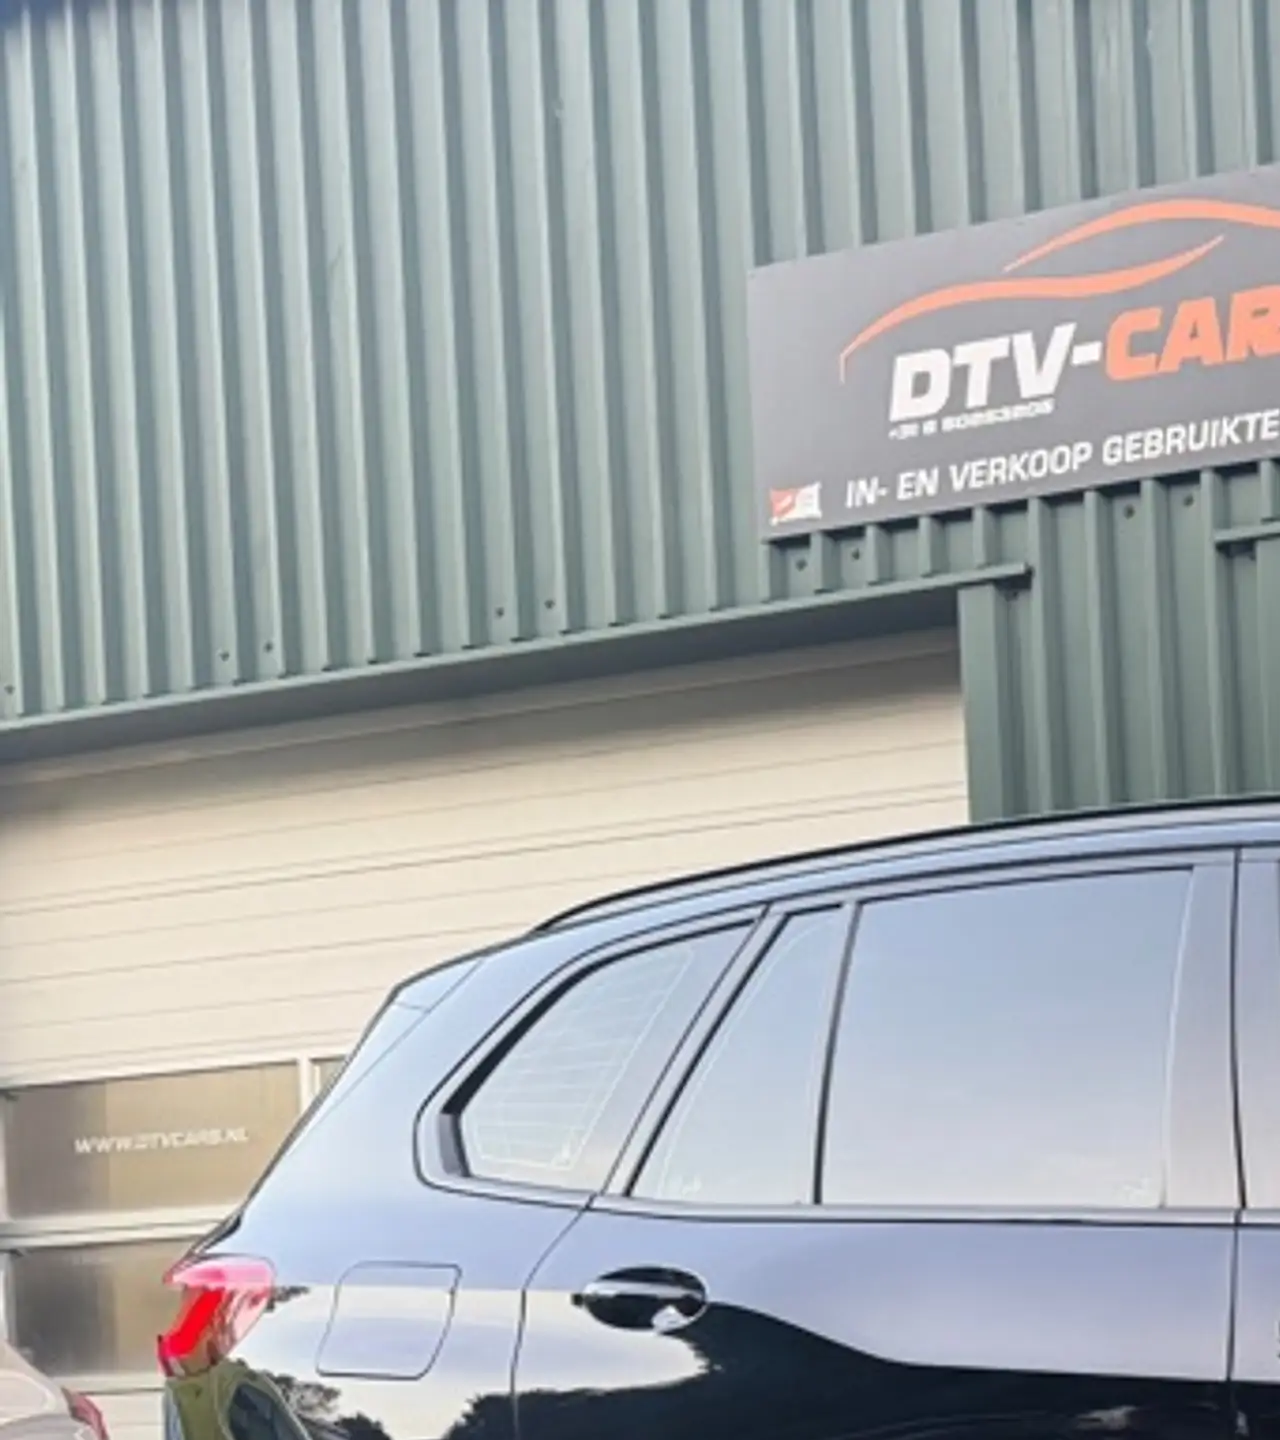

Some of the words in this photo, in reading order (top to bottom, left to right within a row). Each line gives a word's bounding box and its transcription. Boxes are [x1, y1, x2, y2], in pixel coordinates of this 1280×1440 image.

[845, 475, 888, 509] IN-
[896, 466, 940, 501] EN
[949, 440, 1093, 493] VERKOOP
